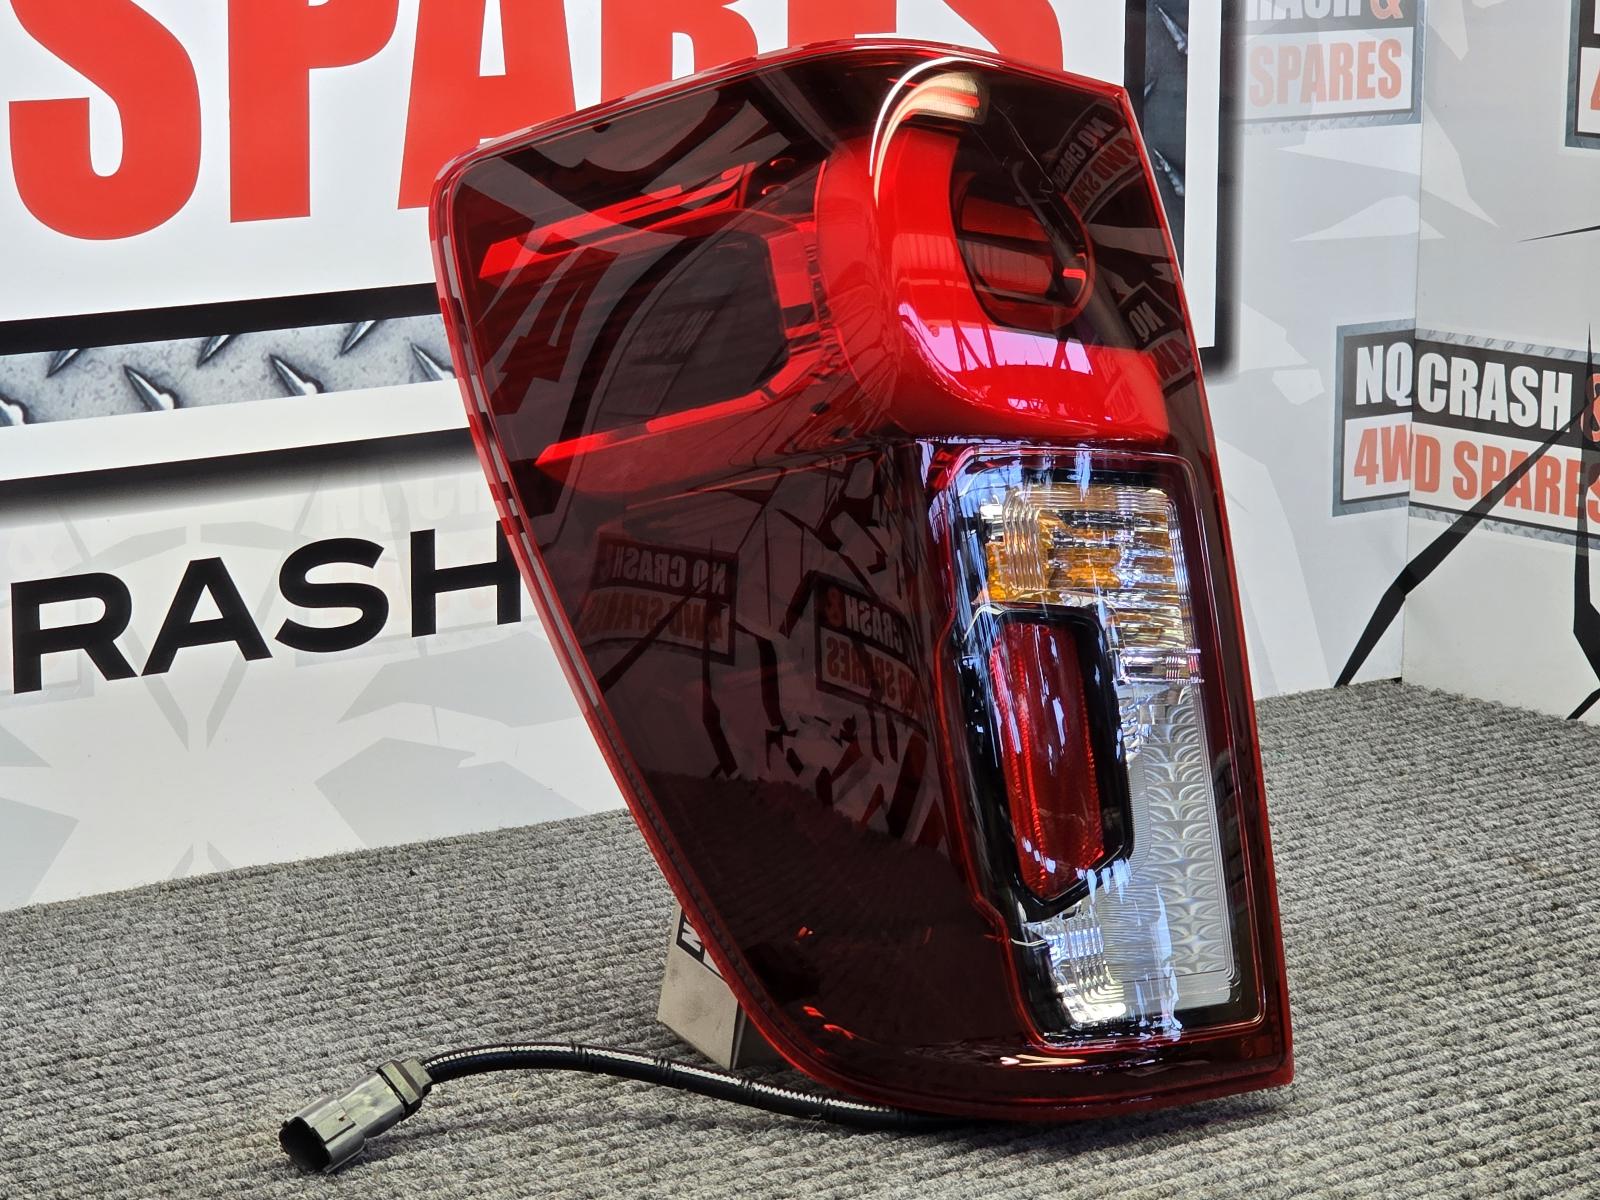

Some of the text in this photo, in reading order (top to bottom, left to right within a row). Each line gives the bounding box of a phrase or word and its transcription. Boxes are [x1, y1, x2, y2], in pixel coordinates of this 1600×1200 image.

[1250, 38, 1402, 107] SPARES
[1417, 352, 1573, 433] CRASH
[1354, 424, 1441, 493] 4WD
